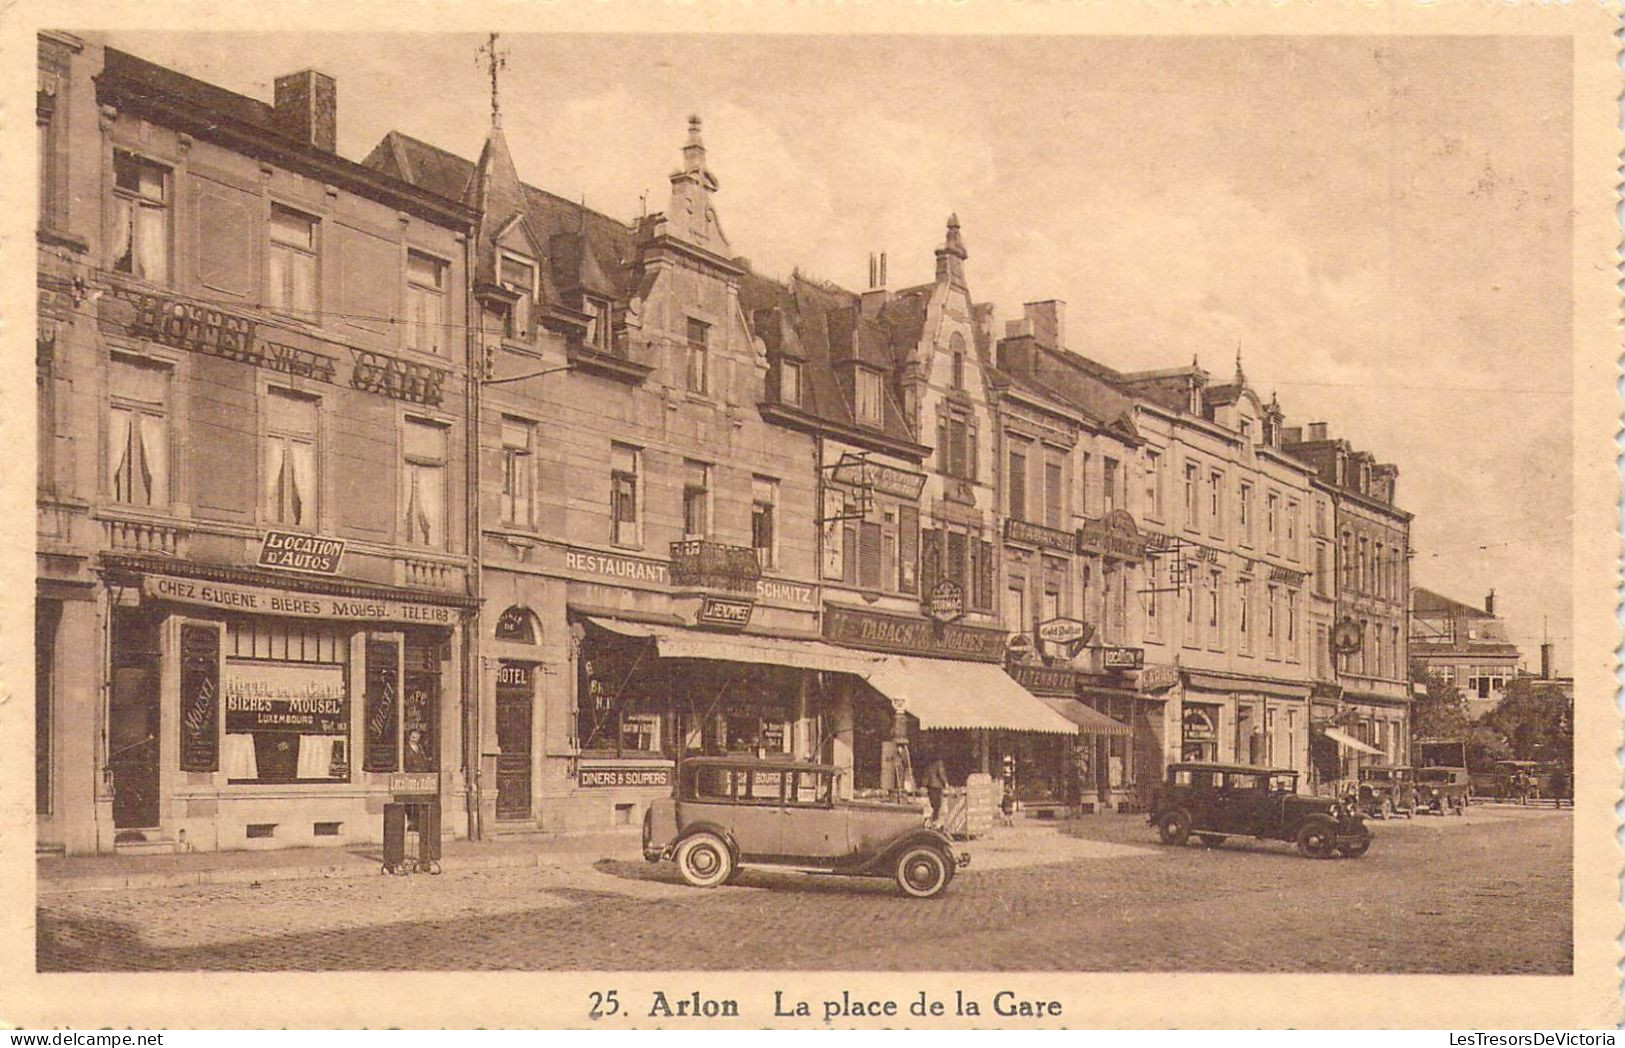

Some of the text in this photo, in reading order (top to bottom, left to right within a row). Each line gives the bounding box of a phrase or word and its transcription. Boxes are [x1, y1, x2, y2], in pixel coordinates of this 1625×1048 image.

[267, 534, 342, 556] LOCATION
[267, 552, 330, 570] D'AUTOS
[566, 552, 811, 603] RESTAURANT SCHMITZ
[158, 579, 196, 599] CHEZ
[289, 699, 340, 714] MOUSEL
[625, 772, 667, 785] SOUPERS
